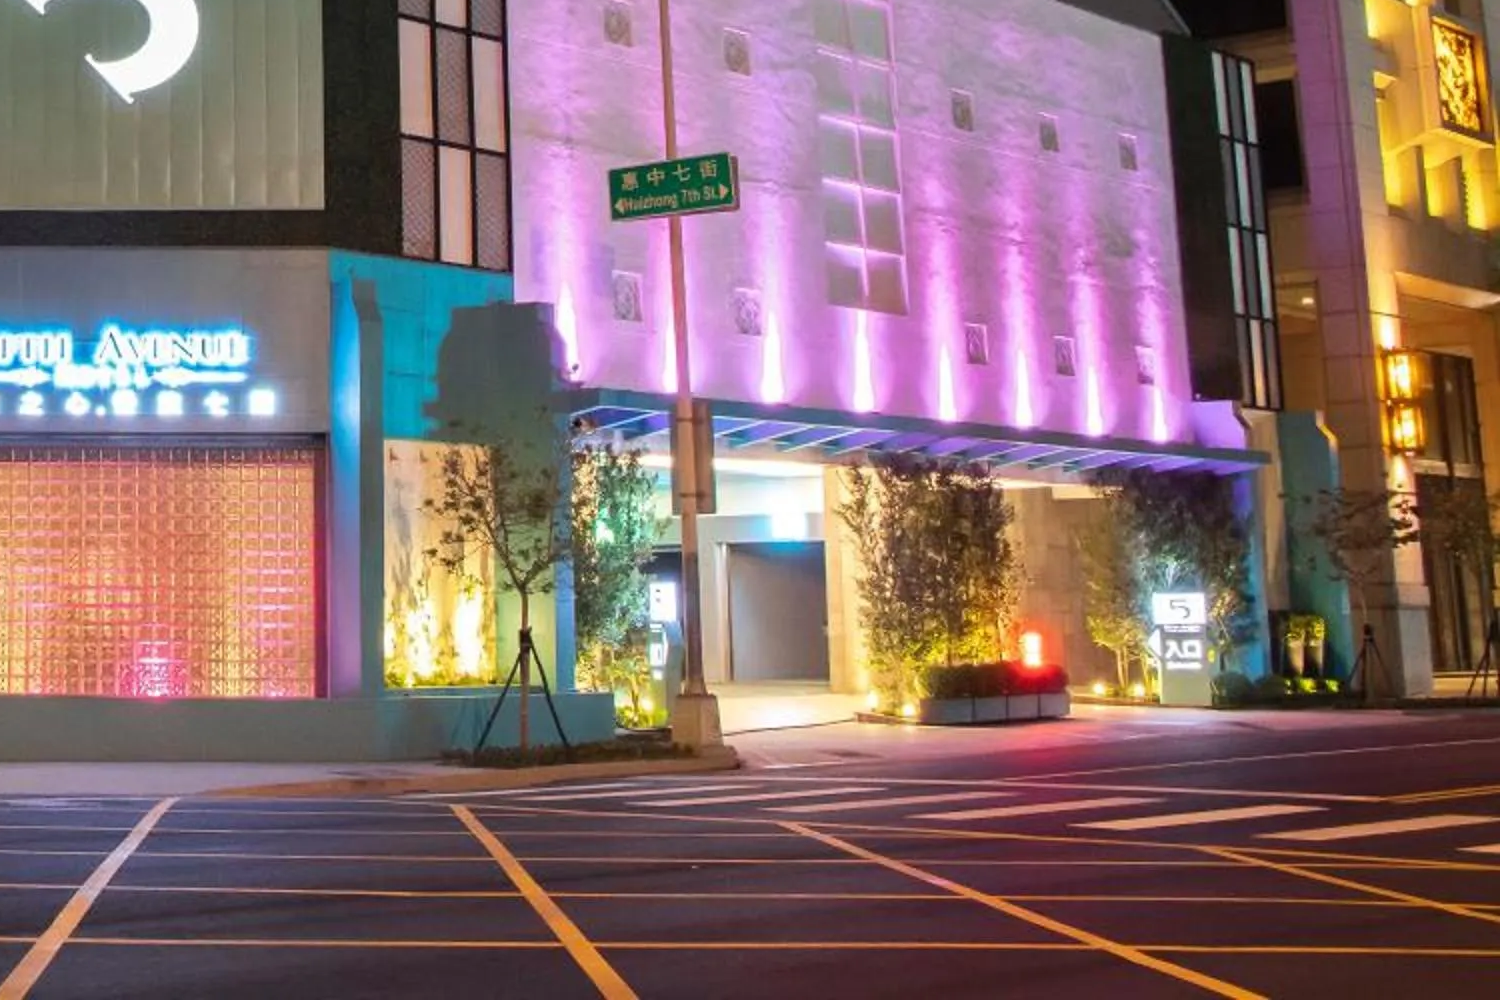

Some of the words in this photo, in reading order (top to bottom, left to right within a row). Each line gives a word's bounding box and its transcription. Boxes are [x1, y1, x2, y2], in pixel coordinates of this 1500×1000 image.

[681, 188, 700, 204] 7th
[96, 327, 248, 365] AVENUE
[1169, 598, 1191, 620] 5
[1165, 639, 1202, 660] 入口
